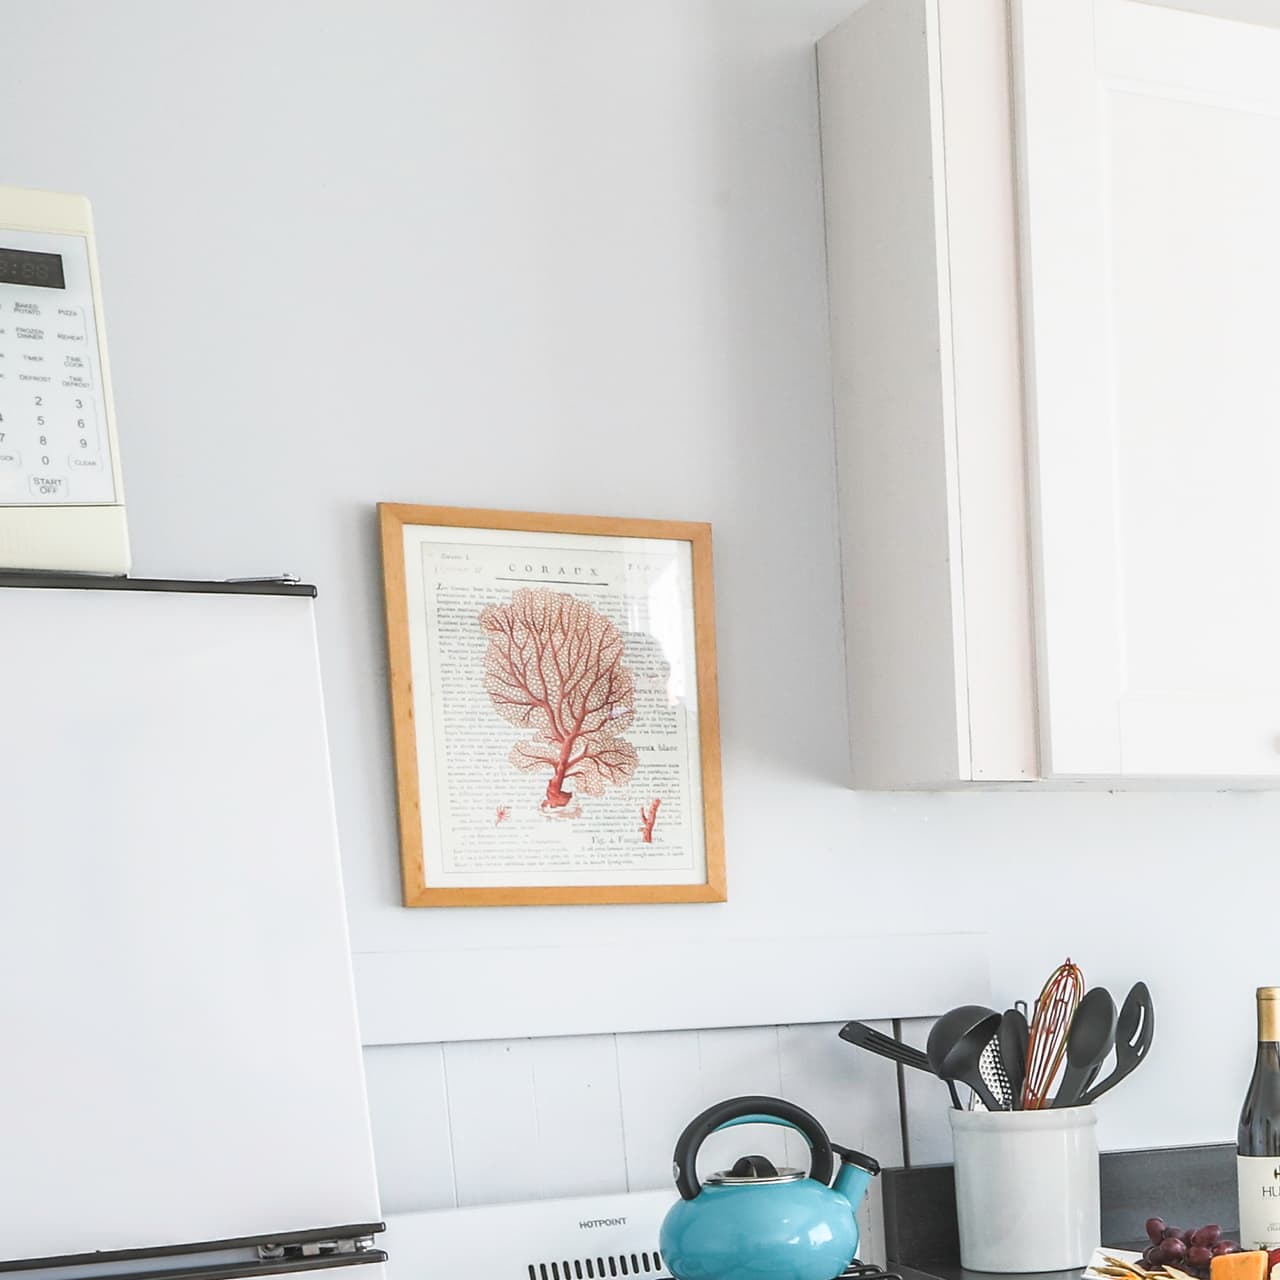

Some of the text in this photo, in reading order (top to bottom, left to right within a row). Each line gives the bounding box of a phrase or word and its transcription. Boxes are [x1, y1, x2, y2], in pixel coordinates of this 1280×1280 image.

[57, 333, 84, 341] REHEAT
[19, 374, 51, 382] DEFROST
[35, 396, 43, 406] 2
[75, 399, 83, 409] 3
[37, 416, 45, 426] 5
[77, 419, 85, 429] 6
[40, 436, 47, 446] 8
[80, 438, 88, 448] 9
[41, 456, 50, 466] 0
[33, 477, 62, 486] START
[40, 486, 56, 494] OFF
[508, 562, 600, 577] CORAUX
[579, 1217, 626, 1229] HOTPOINT
